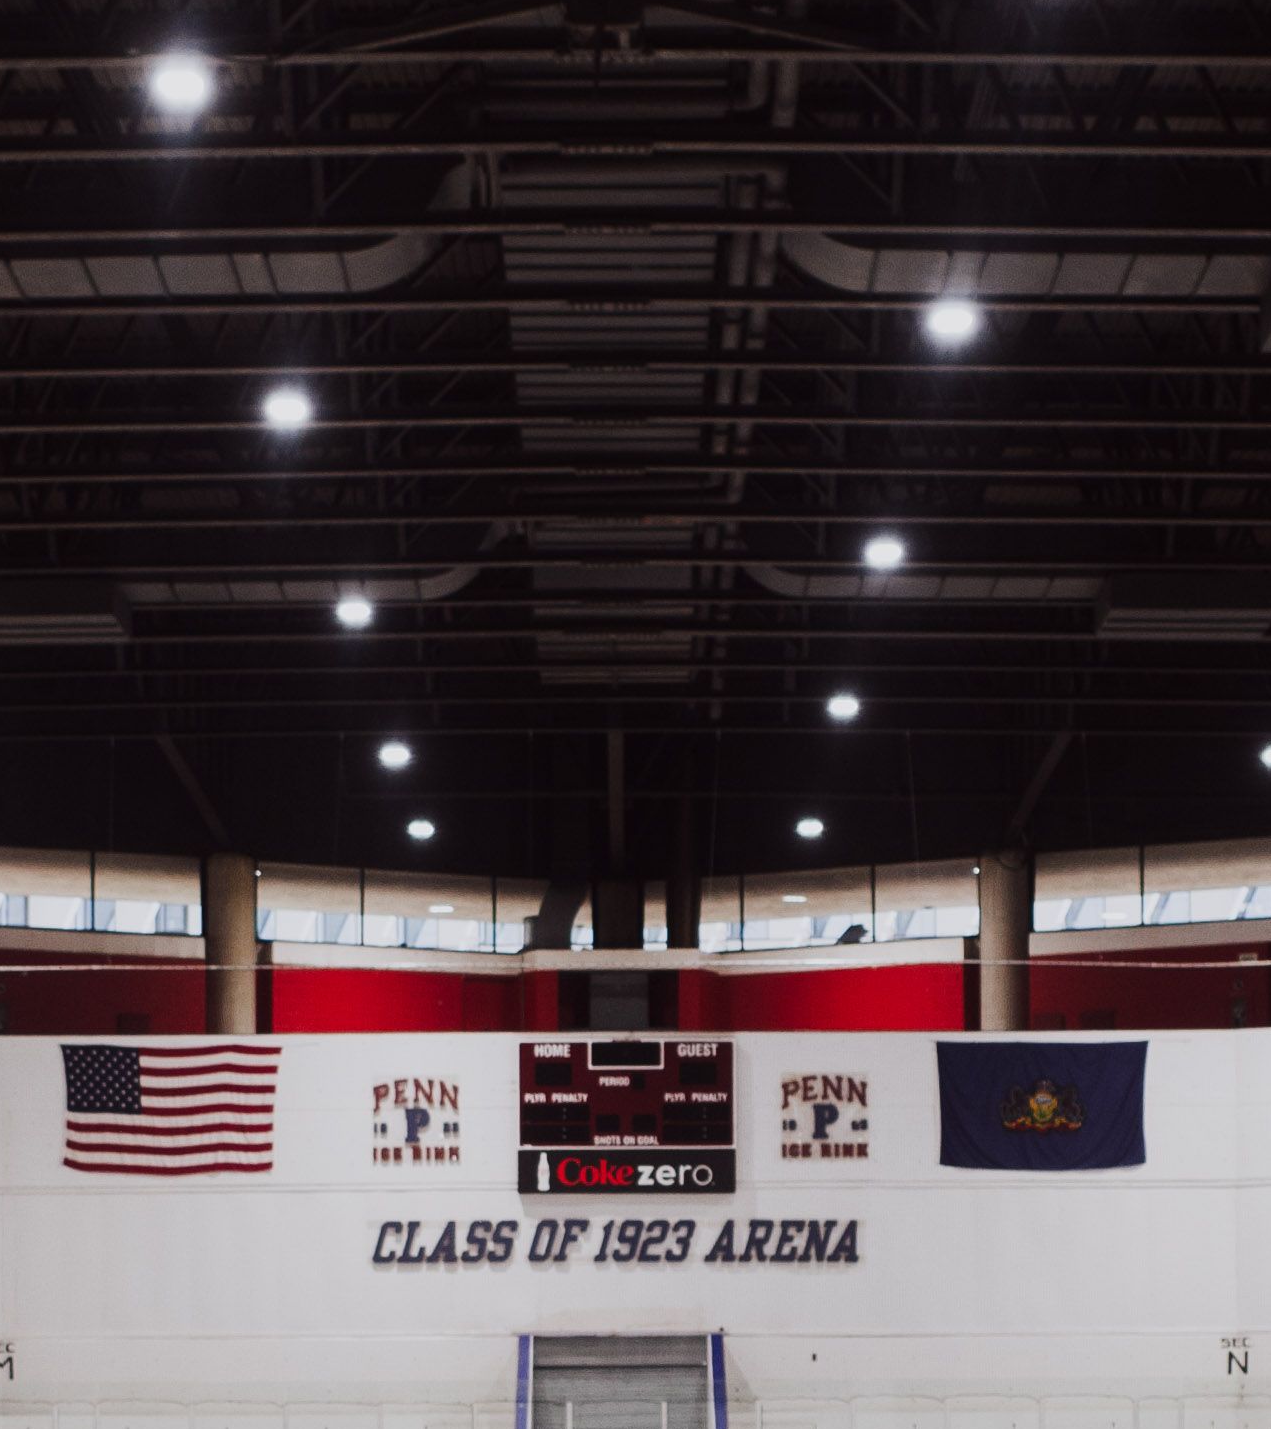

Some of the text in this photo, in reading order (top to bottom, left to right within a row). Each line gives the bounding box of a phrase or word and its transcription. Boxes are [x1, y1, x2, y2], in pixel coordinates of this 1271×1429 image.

[534, 1044, 571, 1058] HOME
[677, 1043, 718, 1057] GUEST
[599, 1076, 630, 1087] PERIOD
[781, 1075, 868, 1110] PENN
[373, 1077, 459, 1113] PENN
[524, 1092, 588, 1103] PLYR PENALTY
[664, 1092, 728, 1102] PLYR PENALTY
[405, 1108, 430, 1143] P
[812, 1103, 839, 1139] P
[594, 1135, 660, 1146] SHOTS ON GOAL
[556, 1157, 713, 1187] Coke zero
[372, 1218, 860, 1264] CLASS OF 1923 ARENA
[1228, 1351, 1248, 1375] N
